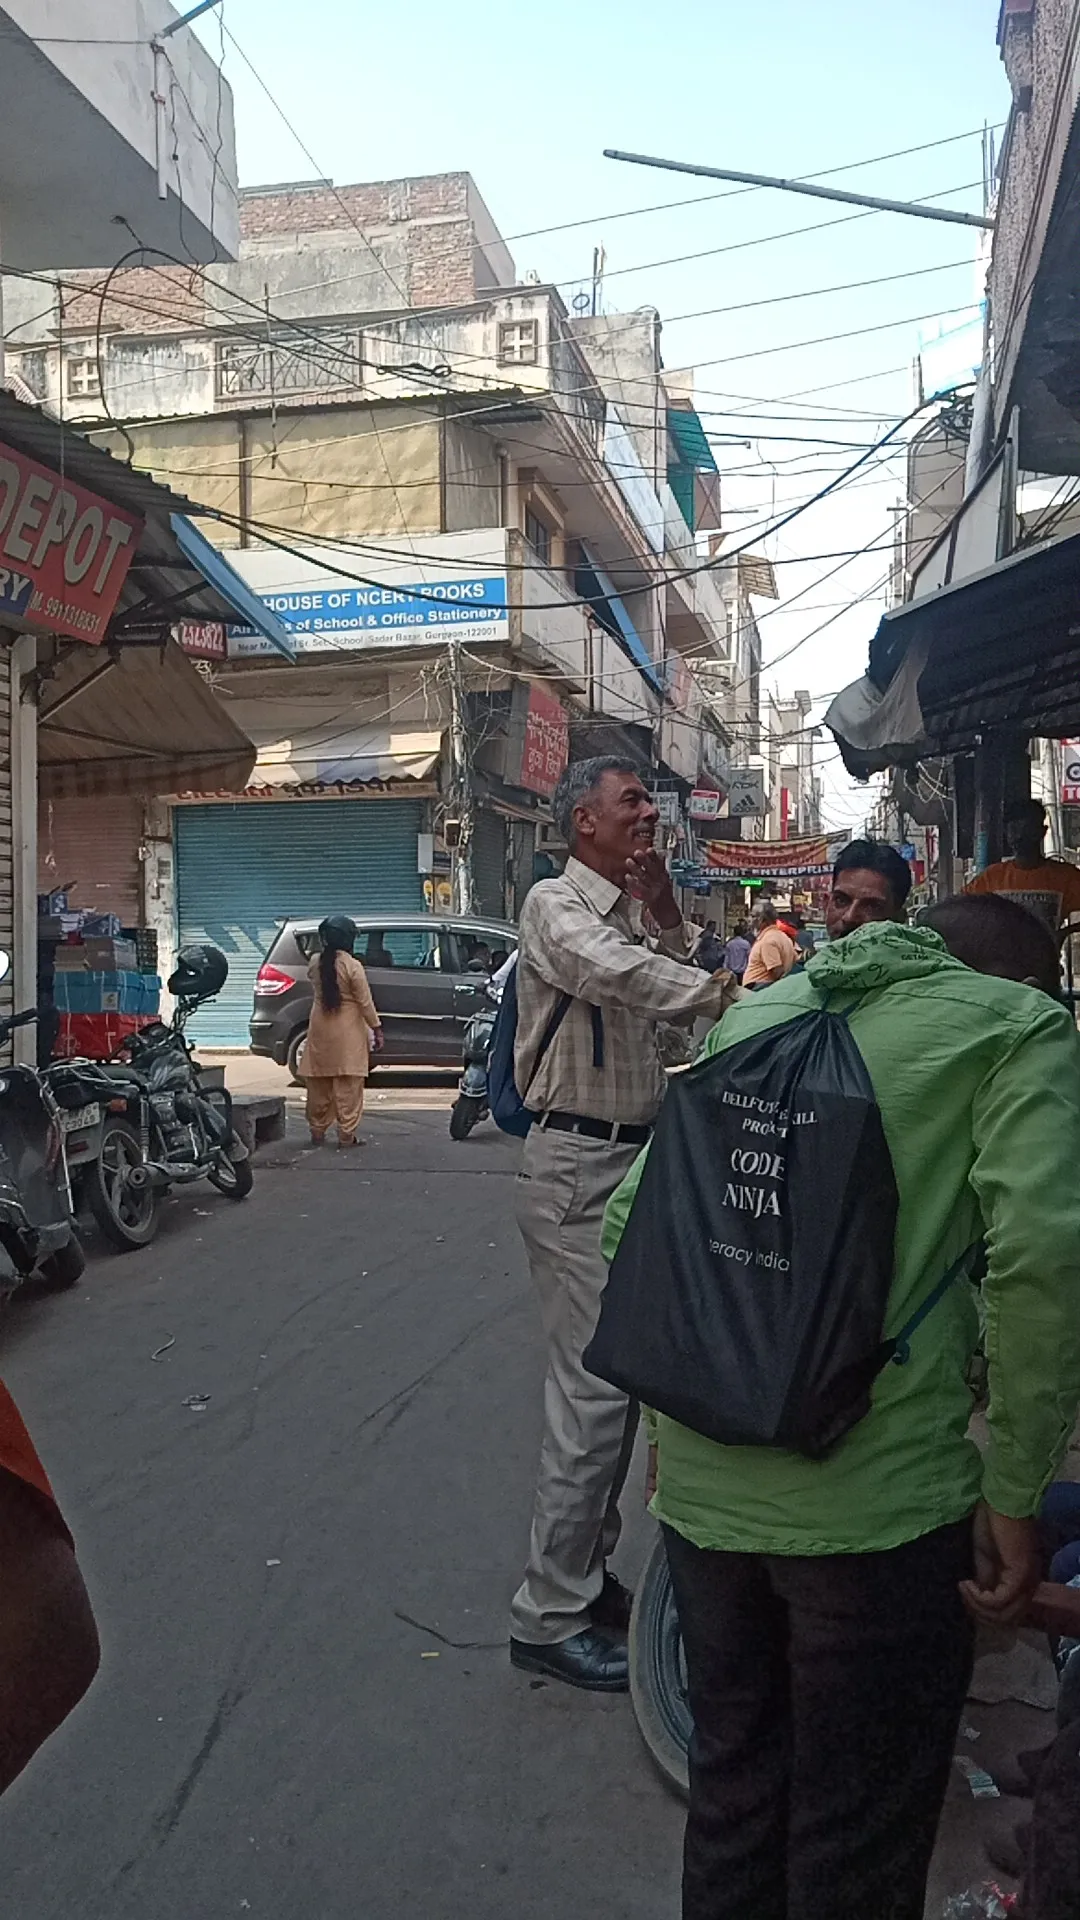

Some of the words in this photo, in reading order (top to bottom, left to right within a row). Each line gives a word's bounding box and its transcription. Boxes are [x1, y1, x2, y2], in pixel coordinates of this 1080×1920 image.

[0, 456, 133, 595] DEPOT
[263, 595, 323, 612] HOUSE
[328, 593, 351, 608] OF
[356, 588, 415, 606] NCERT
[421, 583, 485, 602] BOOKS
[295, 617, 311, 630] of
[314, 616, 363, 630] School
[367, 614, 378, 626] &
[381, 611, 424, 625] Office
[428, 607, 502, 622] Stationery
[368, 634, 393, 643] Sadar
[731, 1148, 785, 1182] CODE
[722, 1183, 782, 1219] NINJA
